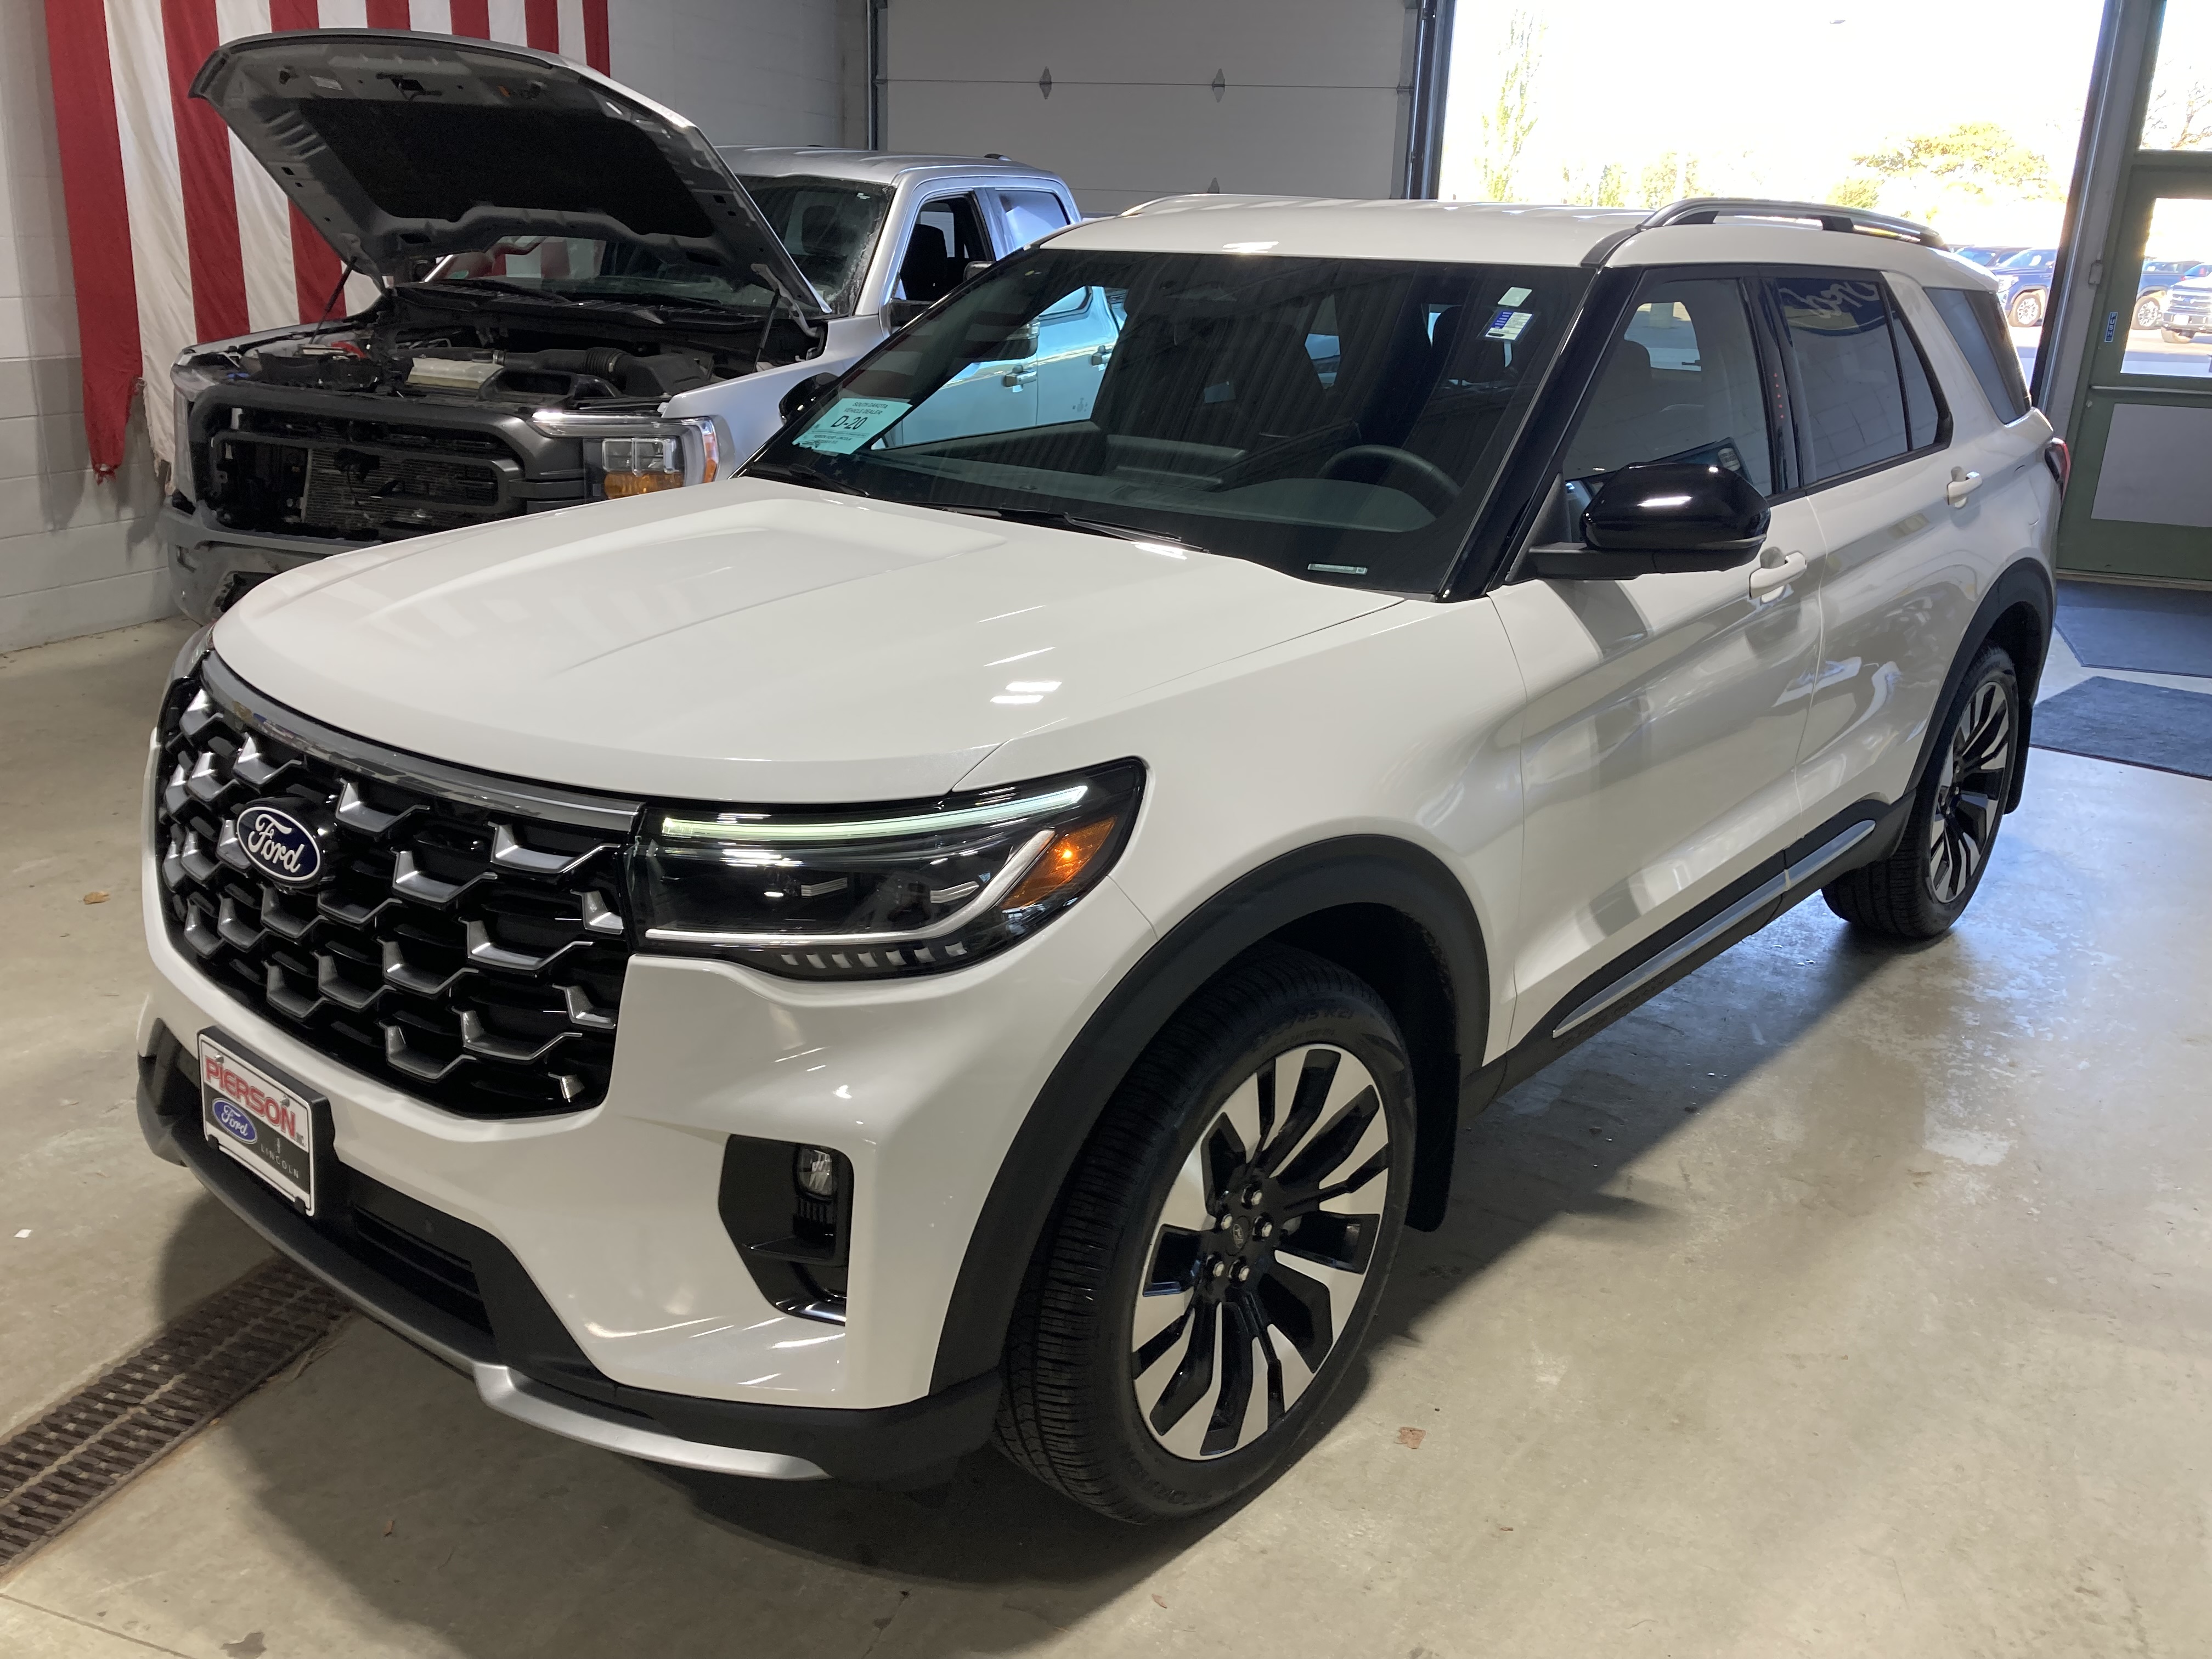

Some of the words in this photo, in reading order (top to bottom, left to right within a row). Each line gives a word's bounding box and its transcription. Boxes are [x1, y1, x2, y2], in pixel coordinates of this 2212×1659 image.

[2107, 312, 2116, 336] PUSH
[831, 415, 868, 430] D-20
[248, 814, 305, 873] Ford
[204, 1055, 296, 1138] PIERSON
[221, 1104, 249, 1136] Ford
[261, 1143, 298, 1178] LINCOLN
